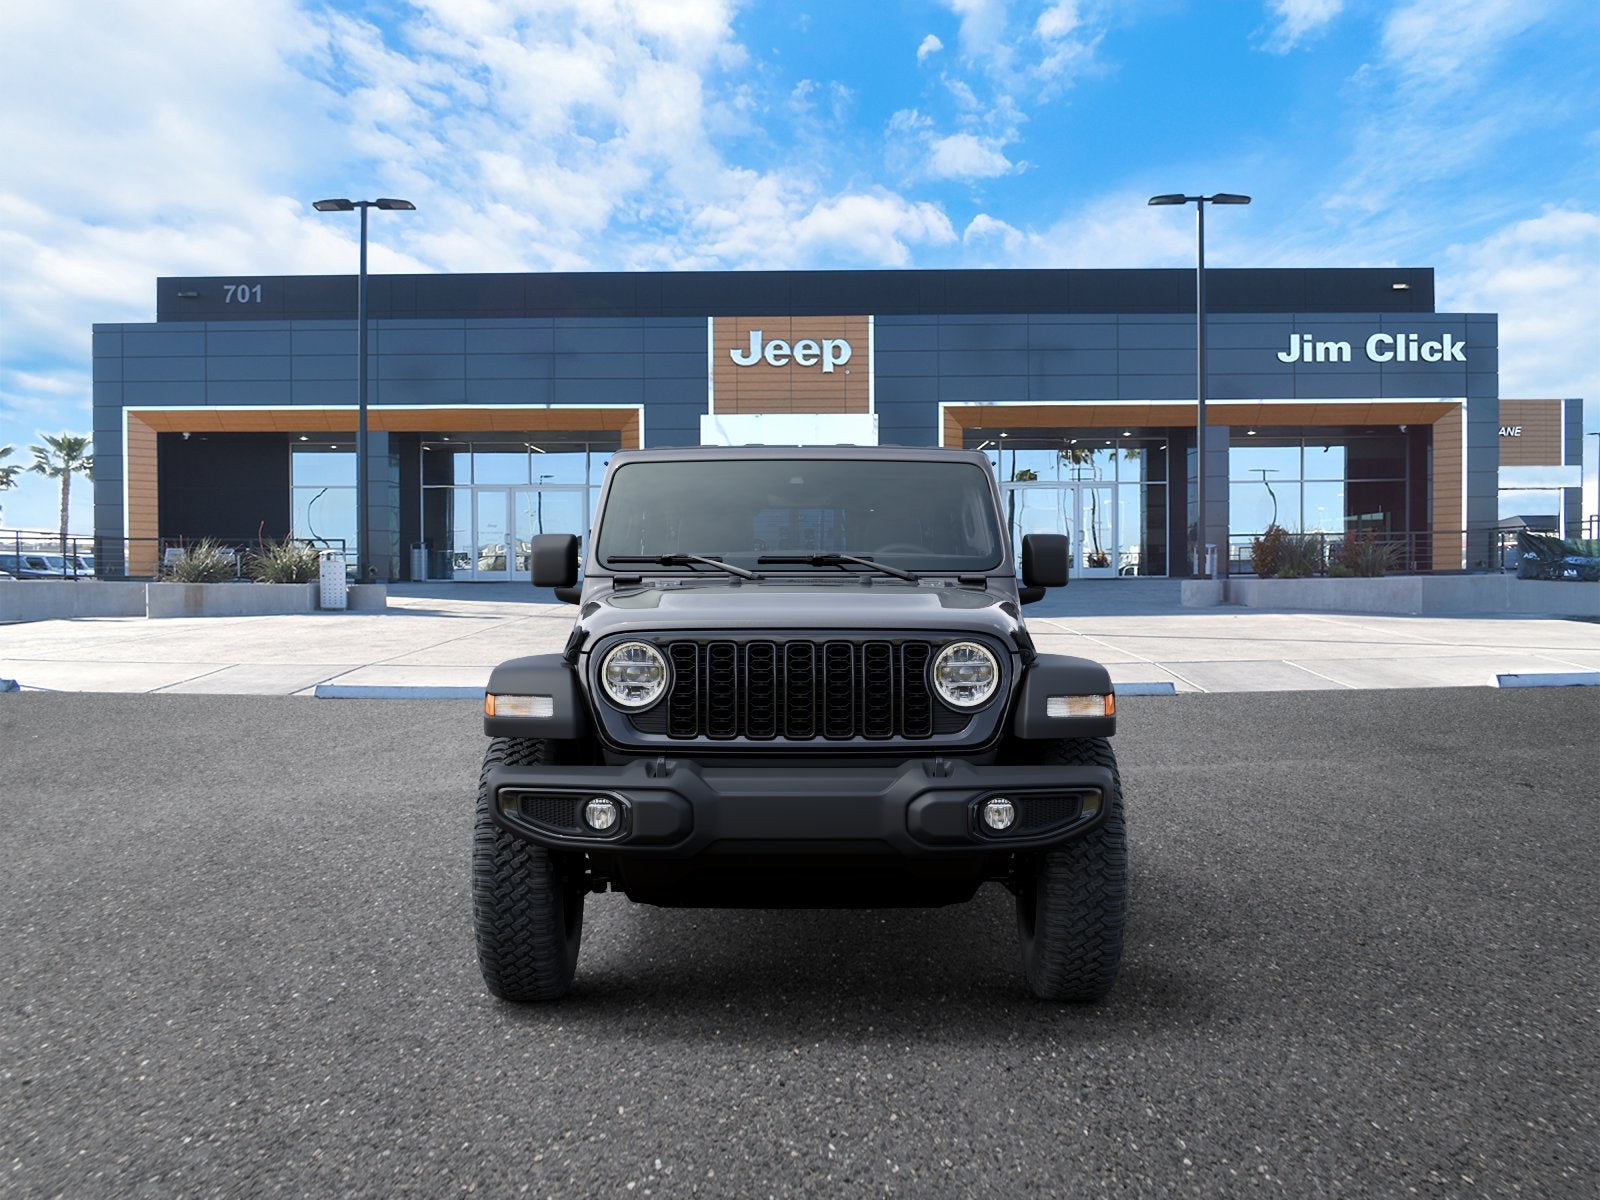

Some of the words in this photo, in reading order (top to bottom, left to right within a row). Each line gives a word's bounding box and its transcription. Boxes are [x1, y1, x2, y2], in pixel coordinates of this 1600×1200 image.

[223, 284, 262, 303] 701
[729, 330, 852, 373] Jeep
[1277, 333, 1351, 363] Jim
[1365, 333, 1467, 362] Click
[1498, 426, 1522, 437] ANE
